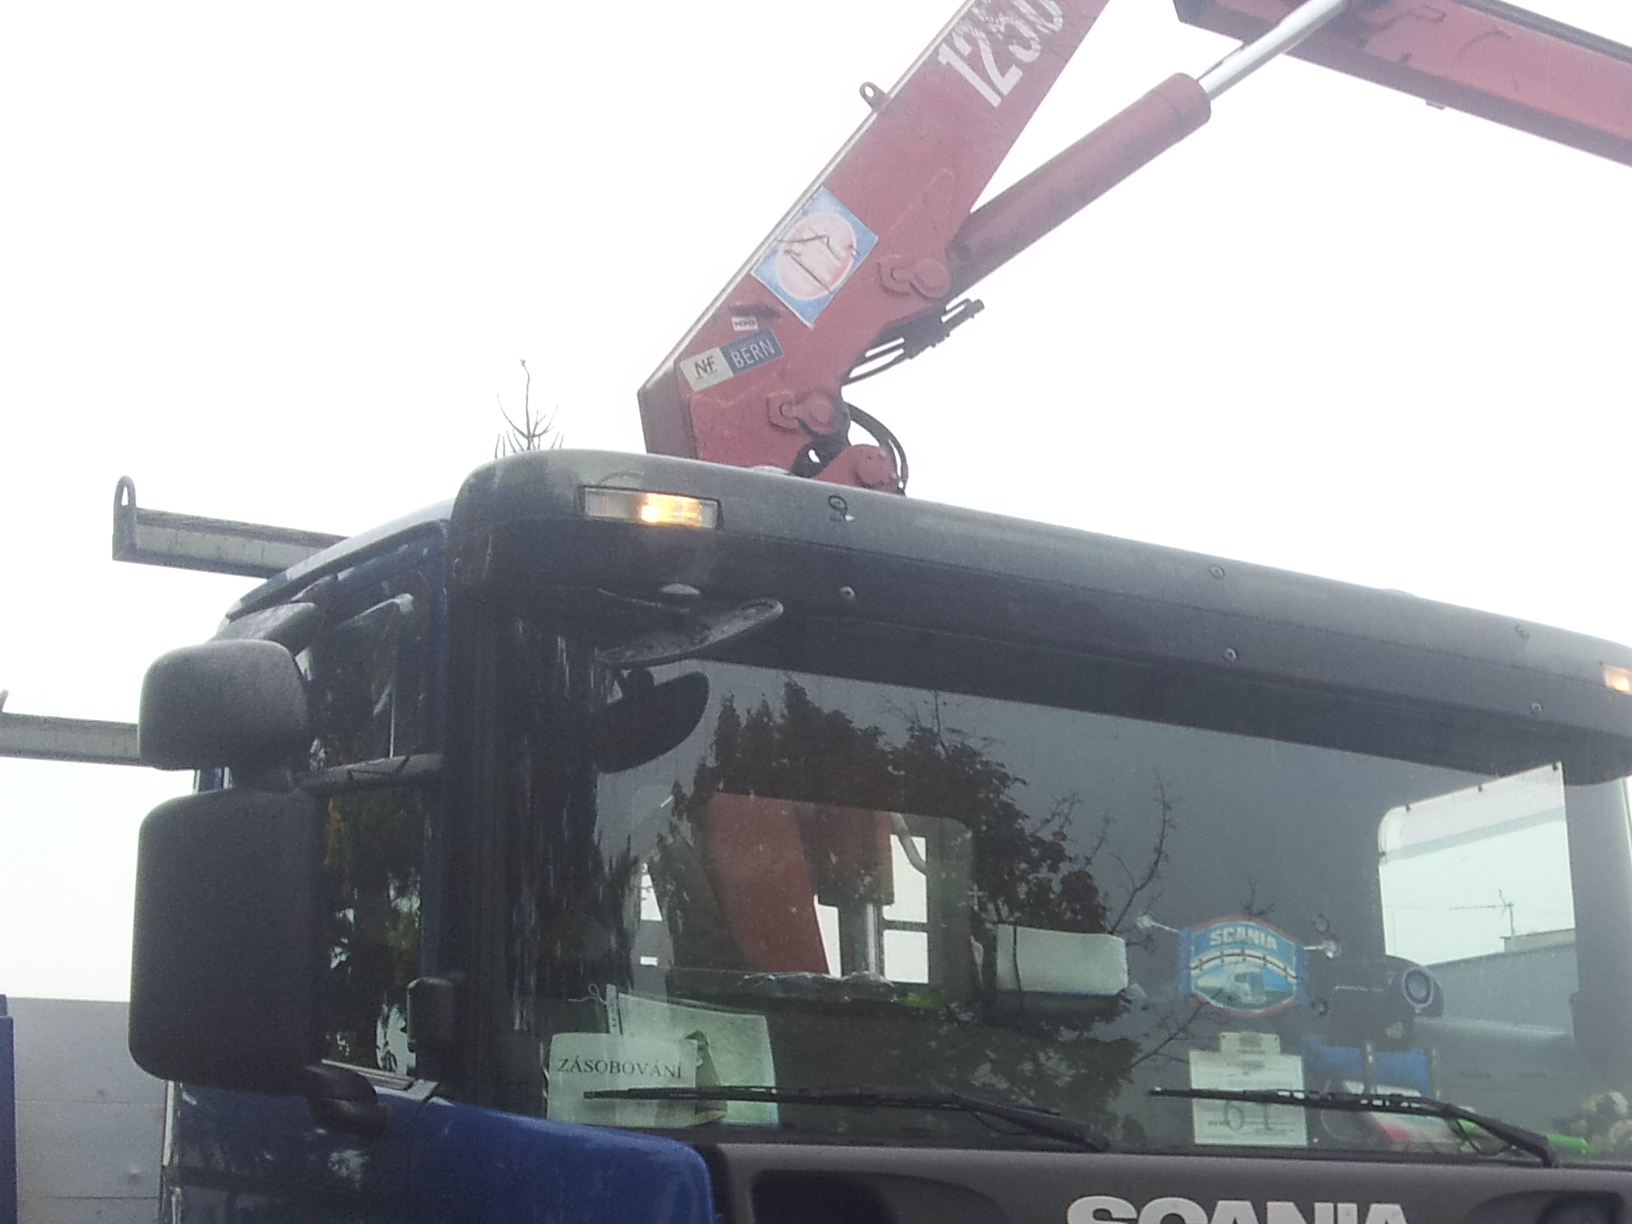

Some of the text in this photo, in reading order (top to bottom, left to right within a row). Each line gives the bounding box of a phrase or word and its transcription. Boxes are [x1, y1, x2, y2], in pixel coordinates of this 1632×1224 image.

[730, 338, 775, 368] BERN
[1209, 926, 1278, 950] SCANIA
[557, 1055, 682, 1079] ZÁSOBOVÁNÍ
